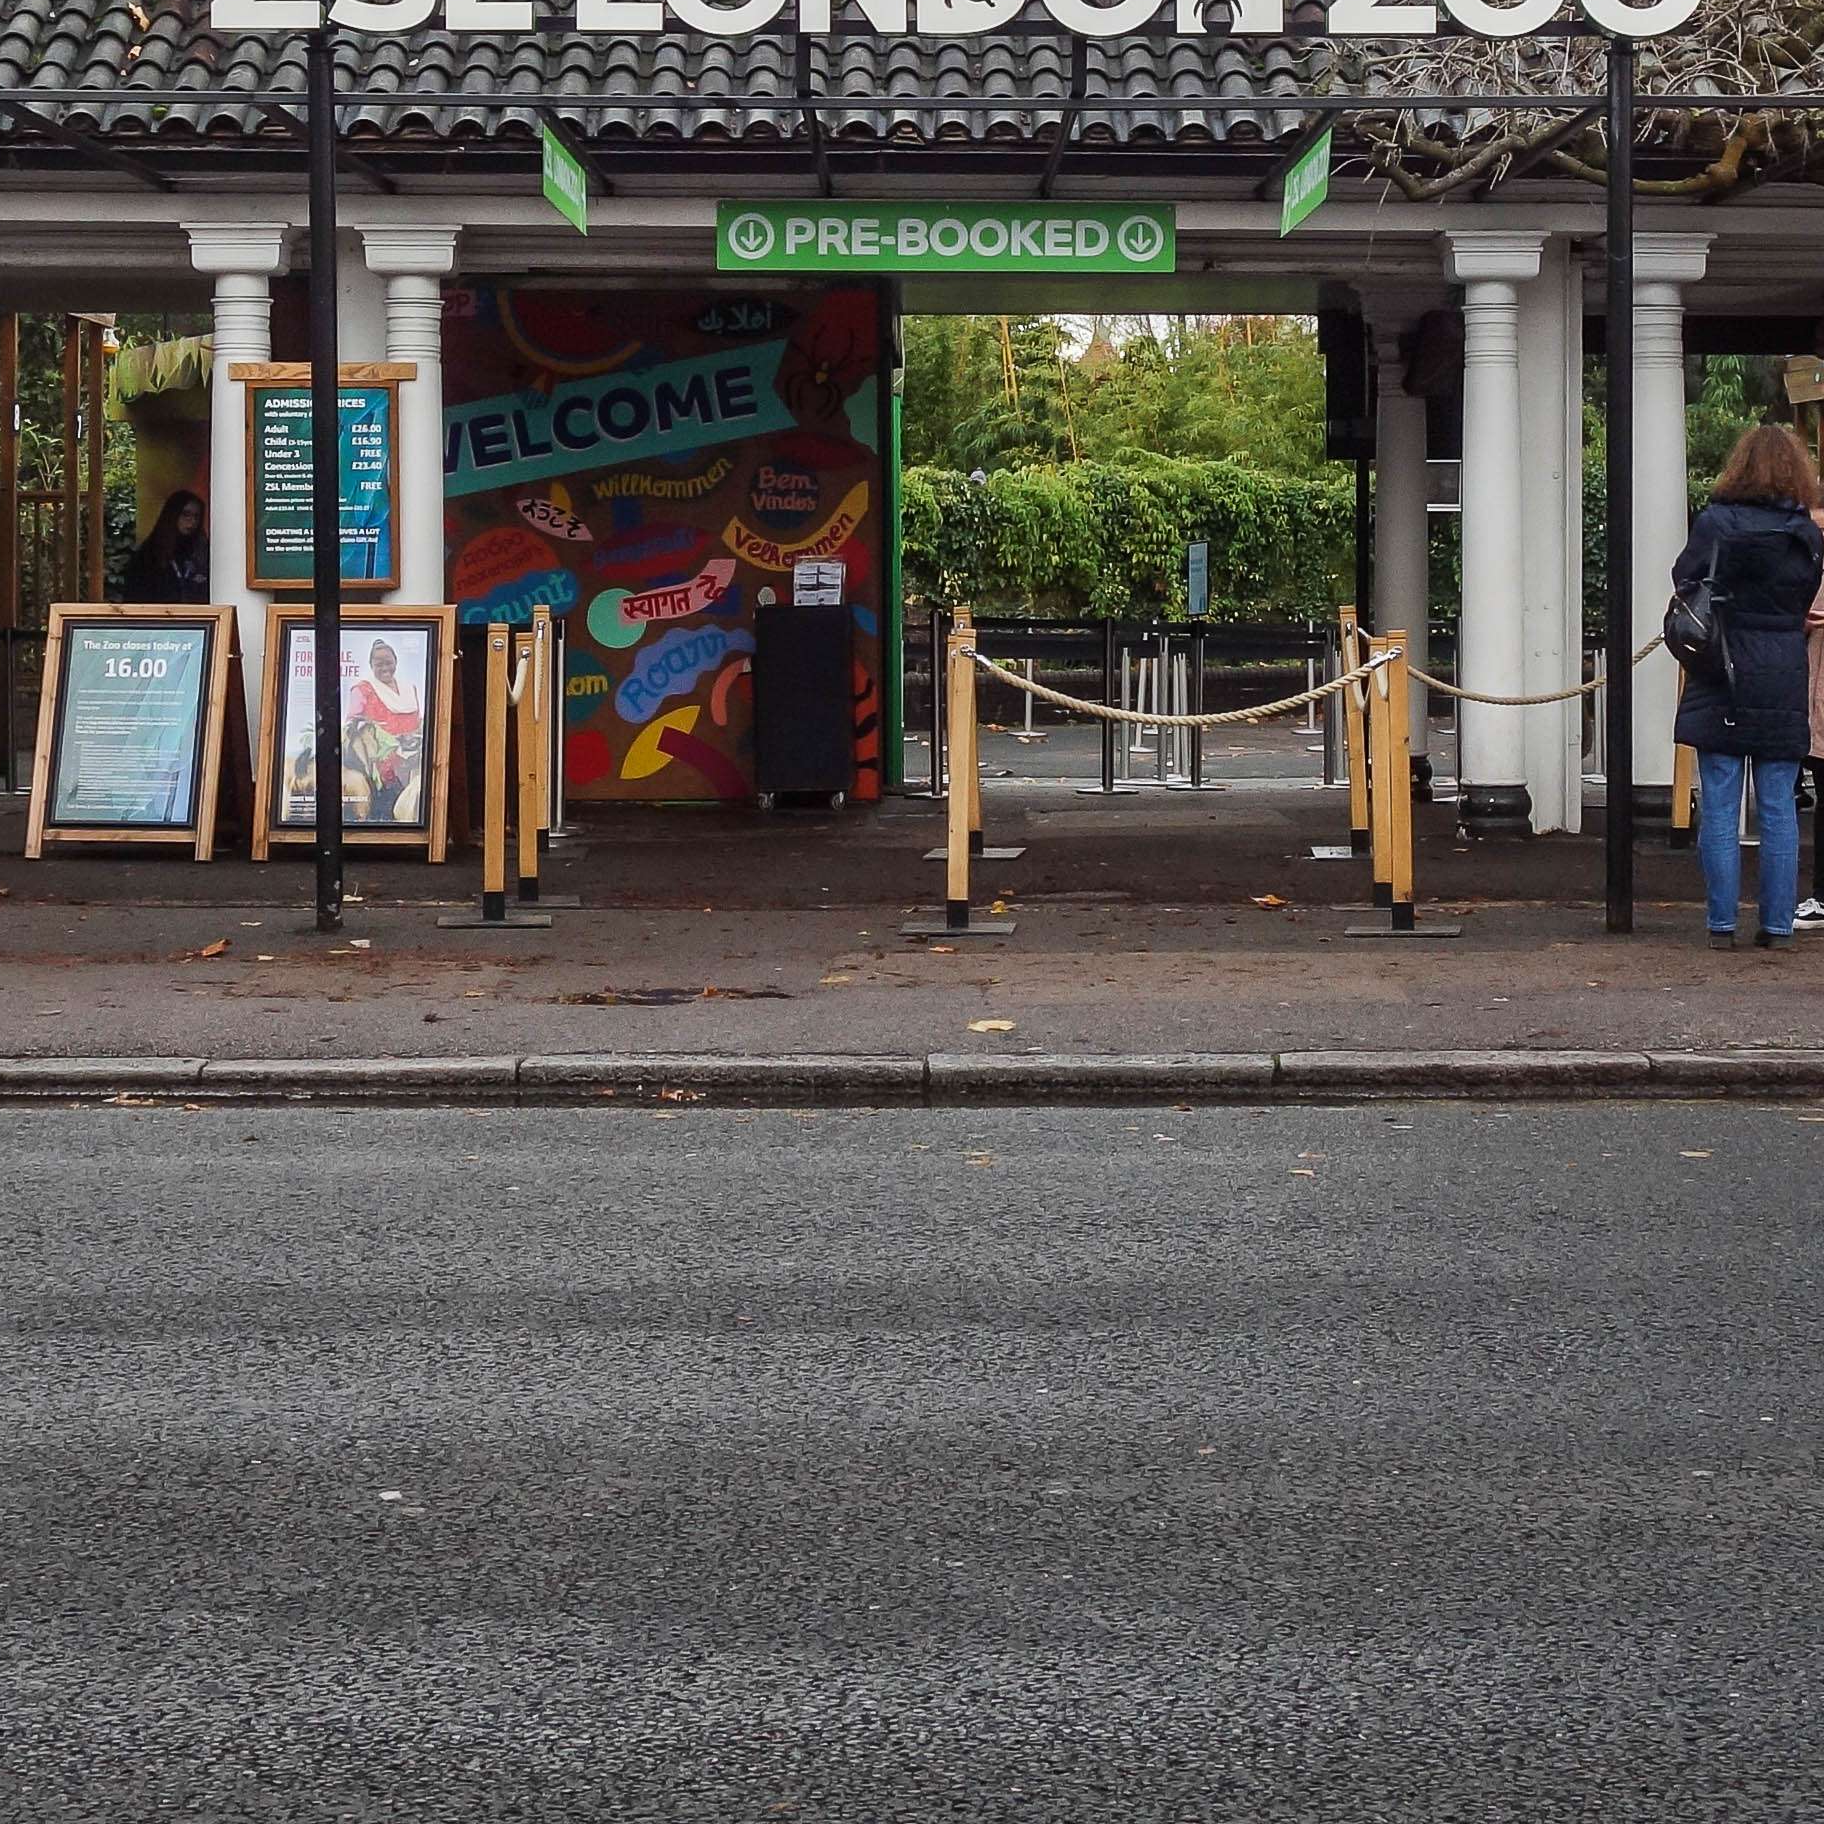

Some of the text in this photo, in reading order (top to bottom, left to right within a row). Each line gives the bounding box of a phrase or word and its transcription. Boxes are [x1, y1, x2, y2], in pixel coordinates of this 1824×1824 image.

[785, 217, 1111, 259] PRE-BOOKED
[264, 398, 313, 409] ADMISSI
[264, 424, 289, 434] Adult
[264, 436, 288, 446] Child
[264, 449, 293, 459] Under
[360, 448, 382, 458] FREE
[264, 482, 281, 491] ZSL
[360, 481, 383, 490] FREE
[522, 499, 582, 538] ようこそ
[83, 640, 193, 652] The Zoo closes today at
[295, 651, 313, 663] FOR
[104, 658, 167, 678] 16.00
[295, 665, 360, 677] FOR LIFE
